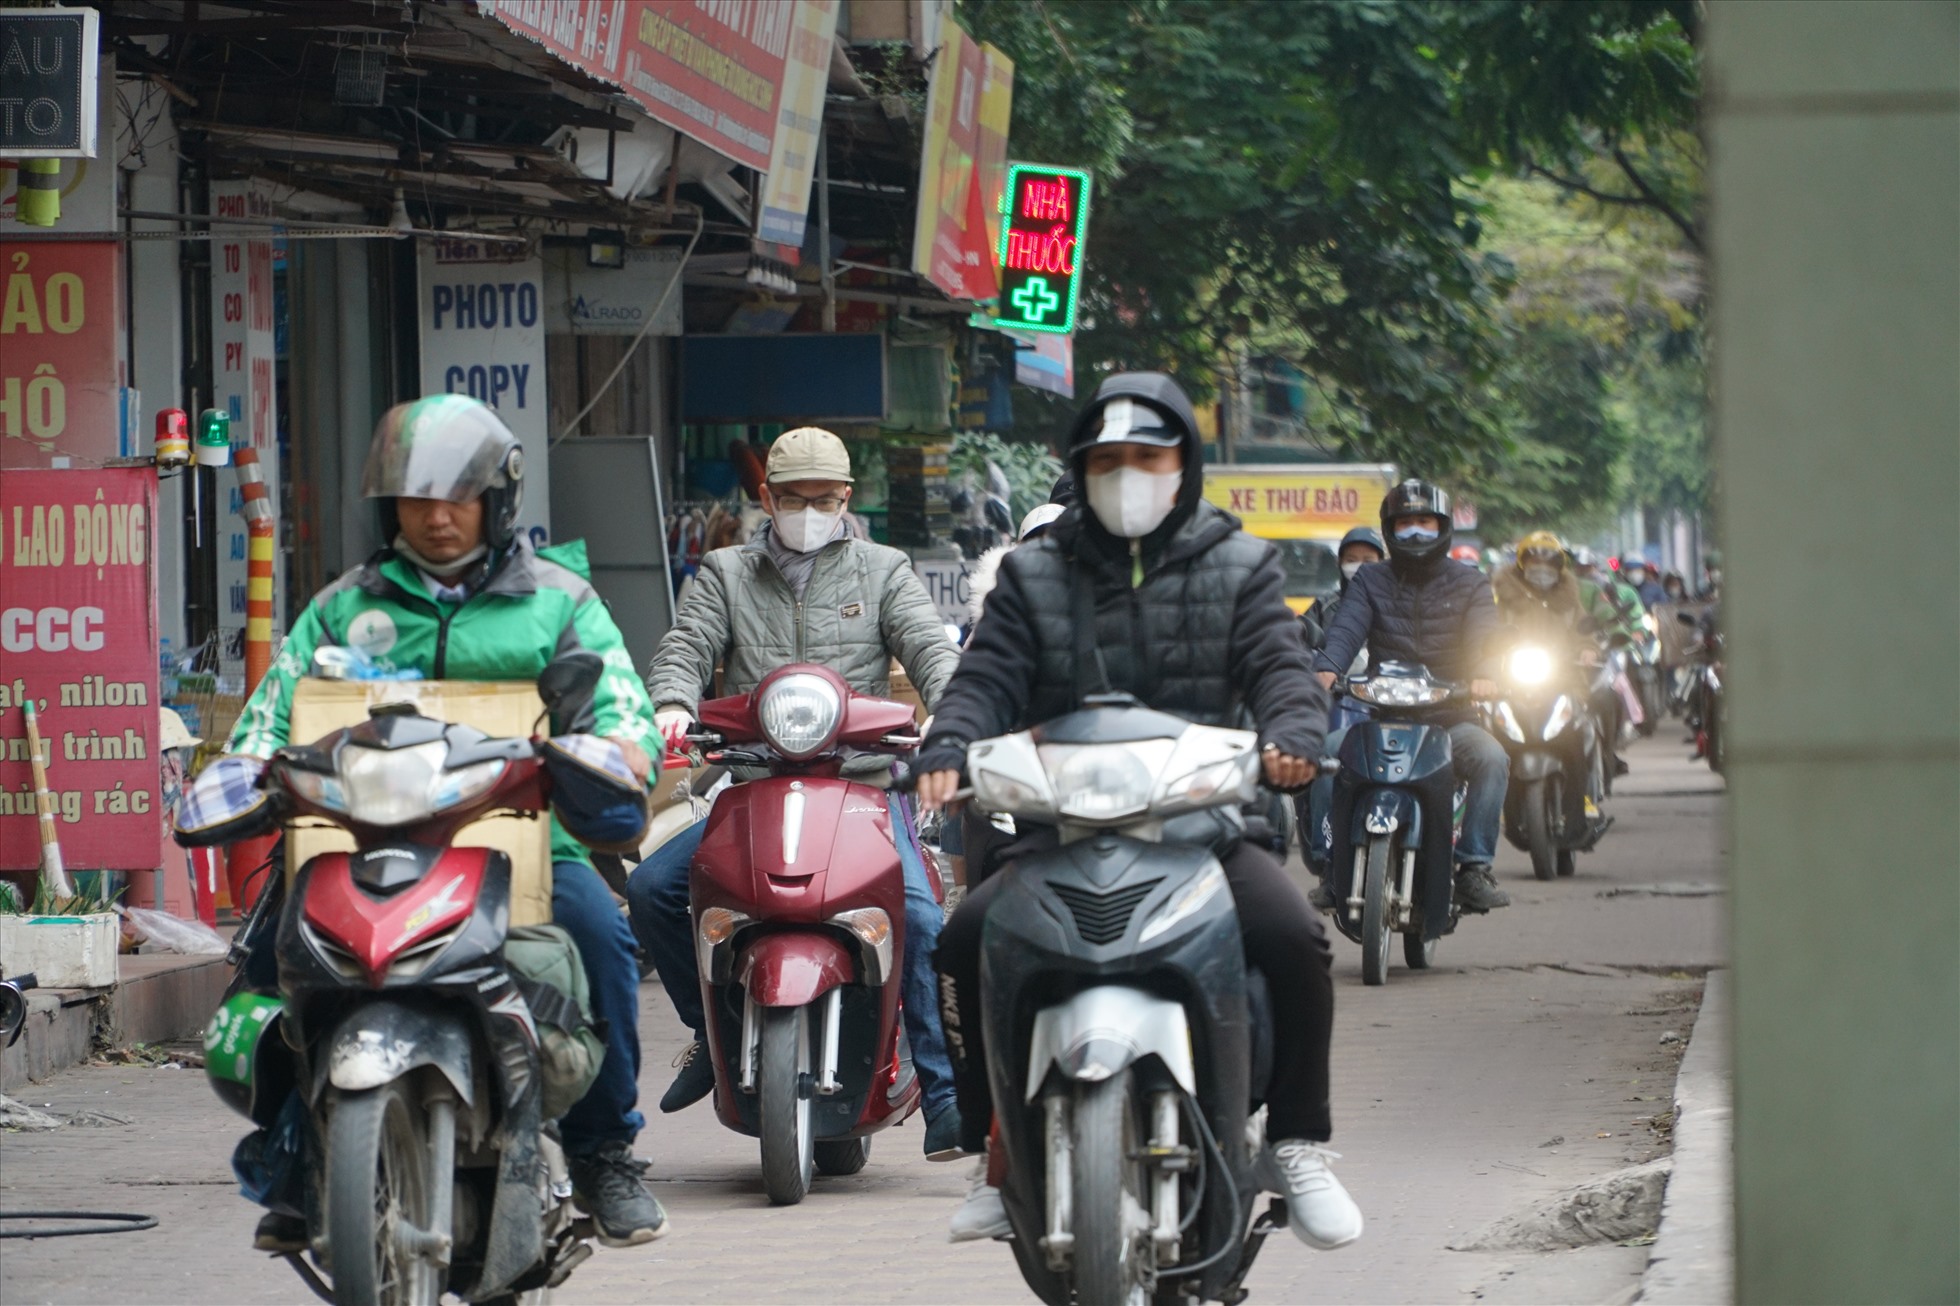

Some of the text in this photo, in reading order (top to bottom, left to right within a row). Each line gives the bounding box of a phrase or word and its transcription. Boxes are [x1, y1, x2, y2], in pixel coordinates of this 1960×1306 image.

[1022, 175, 1070, 222] NHÀ
[223, 243, 241, 273] TO
[1007, 223, 1077, 275] THUỐC
[1, 252, 86, 334] ẢO
[224, 292, 242, 323] CO
[433, 282, 538, 330] PHOTO
[225, 342, 243, 372] PY
[445, 364, 531, 409] COPY
[1229, 488, 1256, 512] XE
[1264, 487, 1309, 512] THƯ
[13, 487, 145, 582] LAO ĐỘNG
[60, 674, 148, 707] nilon
[63, 728, 147, 761] trình
[94, 781, 150, 814] rác
[940, 972, 961, 1027] NIKE
